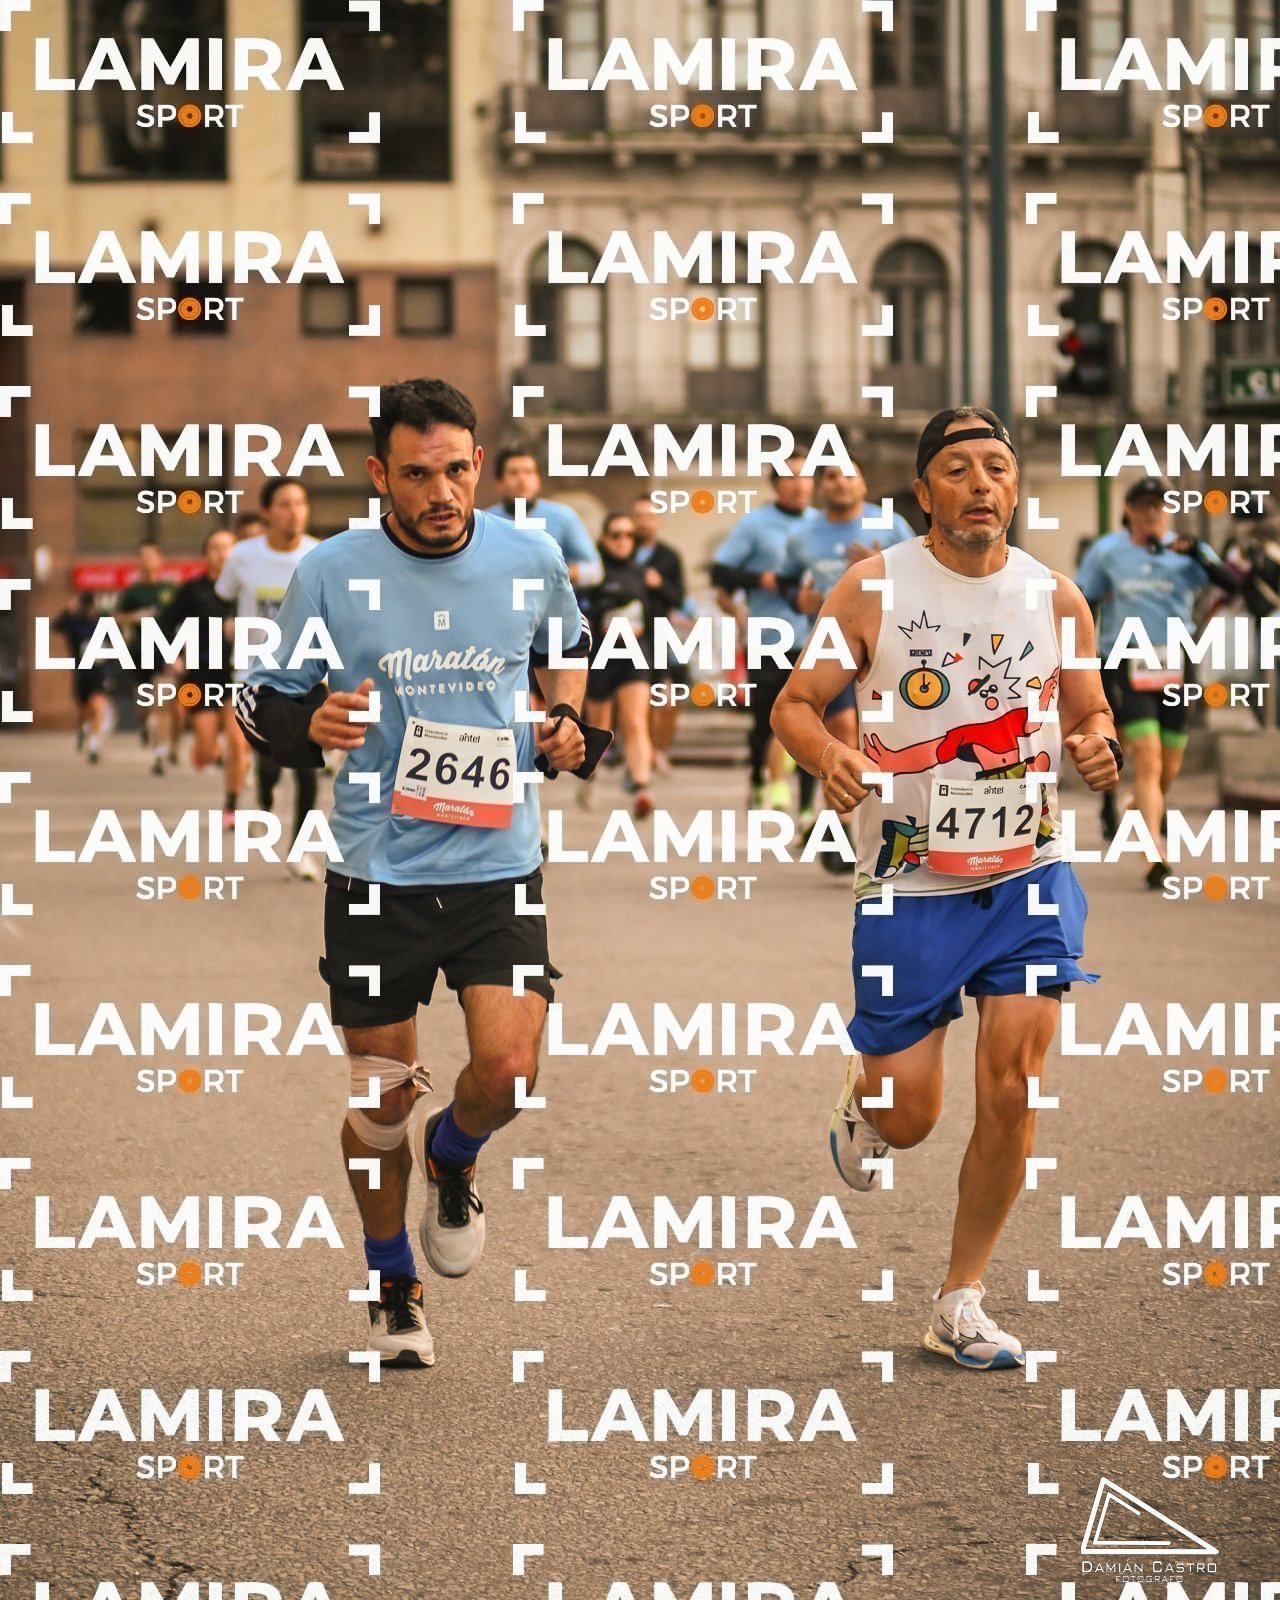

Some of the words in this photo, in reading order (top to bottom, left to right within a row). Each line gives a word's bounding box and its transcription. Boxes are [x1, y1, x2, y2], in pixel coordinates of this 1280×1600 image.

[378, 645, 506, 681] Maratón
[394, 679, 497, 697] MONTEVIDEO
[405, 748, 510, 790] 2646
[433, 802, 475, 817] Maratón
[936, 804, 1034, 839] 4712
